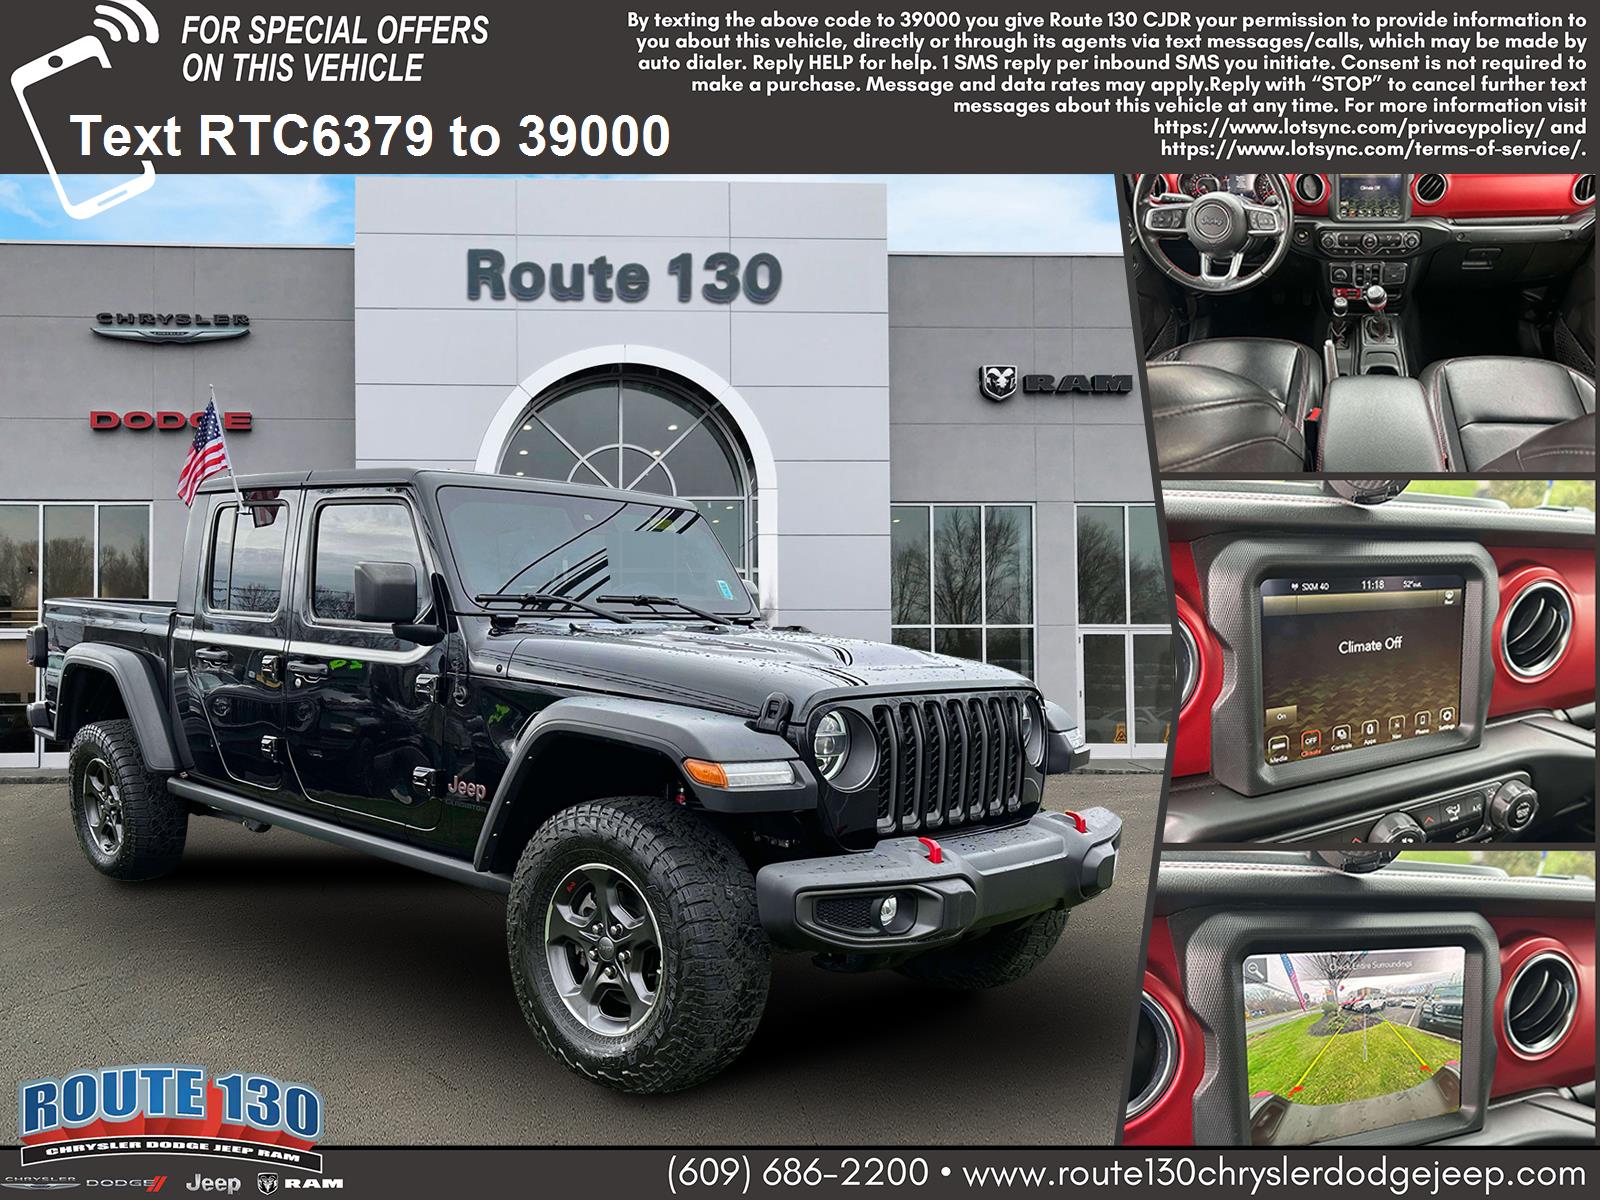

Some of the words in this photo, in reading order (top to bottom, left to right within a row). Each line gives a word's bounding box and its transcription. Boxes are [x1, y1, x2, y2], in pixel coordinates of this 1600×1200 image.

[467, 248, 650, 302] Route
[668, 252, 782, 304] 130
[96, 312, 250, 326] CHRYSLER
[1023, 374, 1133, 394] RAM
[1361, 580, 1384, 590] 11:18
[1338, 639, 1382, 655] Climate
[1385, 636, 1403, 650] Off
[447, 775, 487, 802] Jeep
